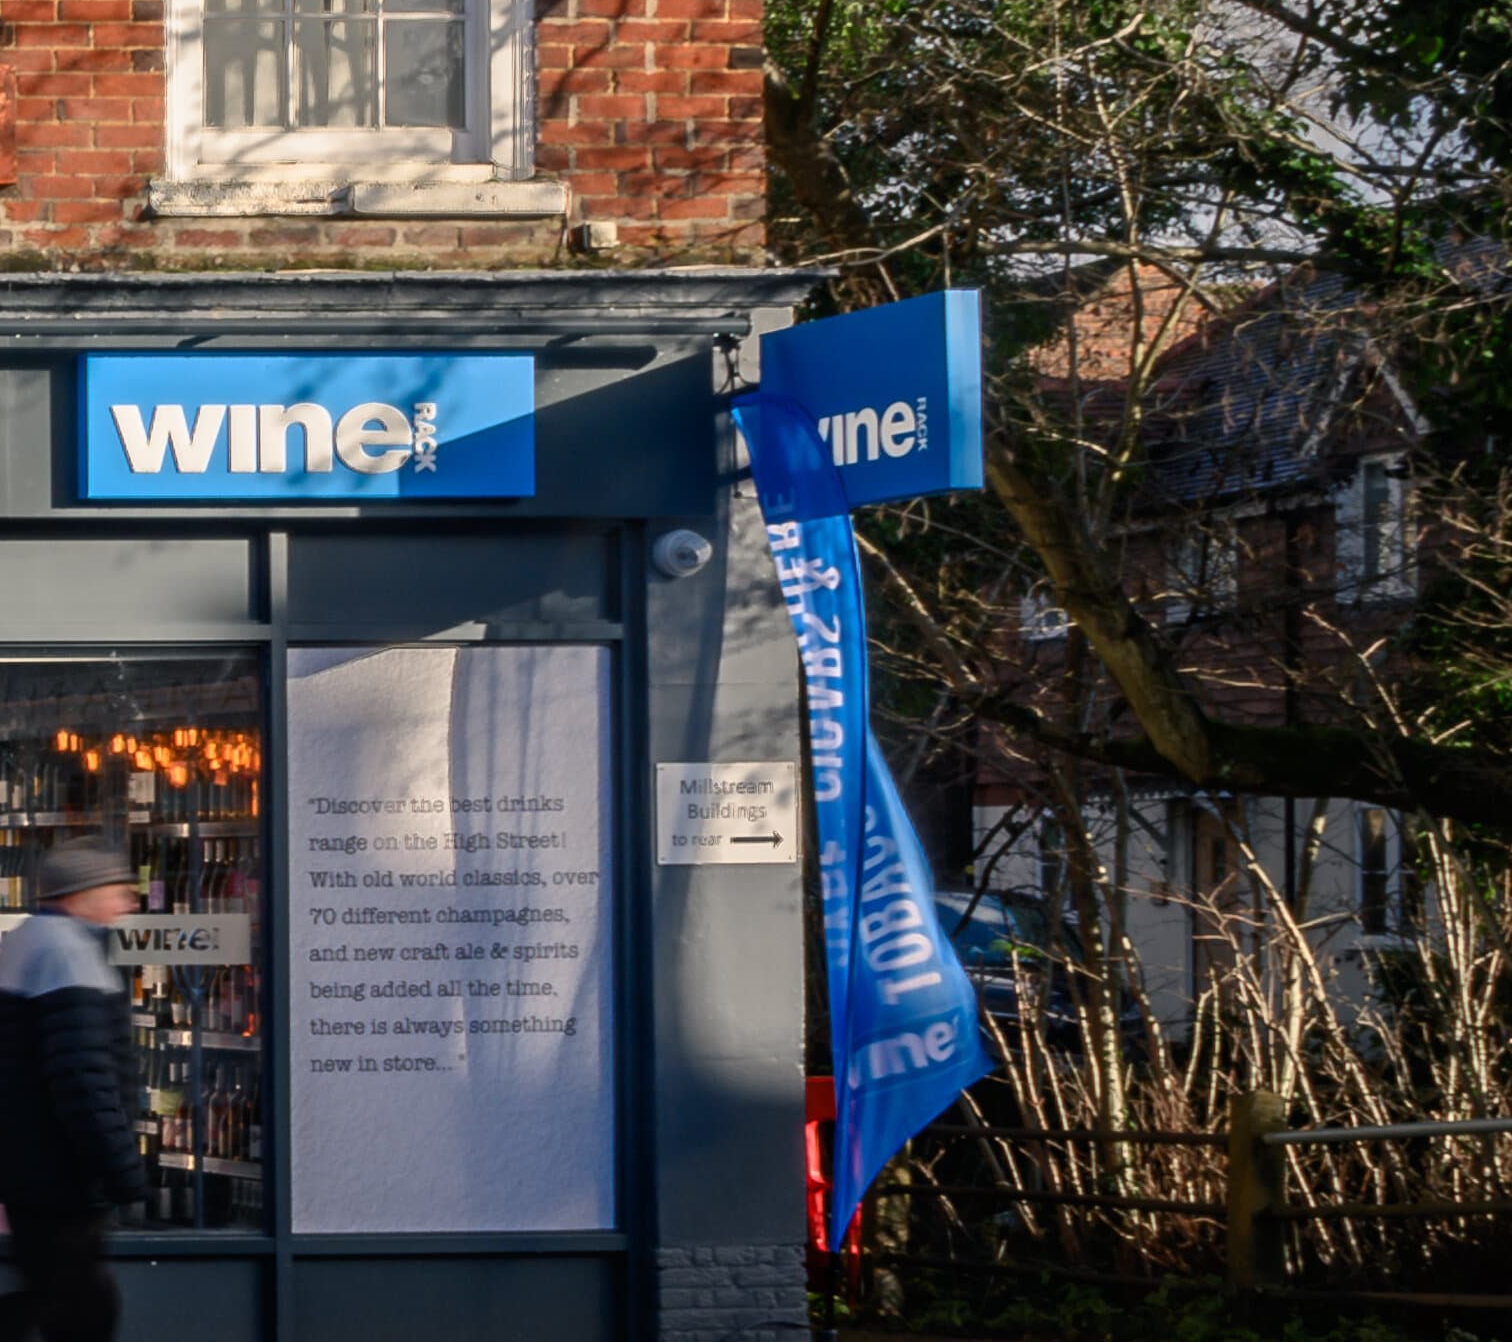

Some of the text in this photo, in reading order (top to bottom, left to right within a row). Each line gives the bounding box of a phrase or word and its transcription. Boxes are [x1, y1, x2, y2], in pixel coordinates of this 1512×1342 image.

[916, 397, 927, 451] RACK
[109, 402, 437, 474] wine RACK
[680, 778, 774, 795] Millstream
[410, 796, 445, 814] the
[451, 796, 493, 813] best
[498, 795, 564, 812] drinks
[687, 803, 768, 822] Buildings
[309, 831, 567, 855] range on the High Street!
[672, 834, 722, 846] to rear
[309, 868, 601, 889] With old world classics, over
[309, 906, 570, 927] 70 different champagnes,
[309, 942, 579, 963] and new craft ale & spirits
[309, 979, 559, 1002] being added all the time,
[310, 1016, 577, 1039] there is always something
[310, 1059, 353, 1073] new
[357, 1055, 378, 1072] in
